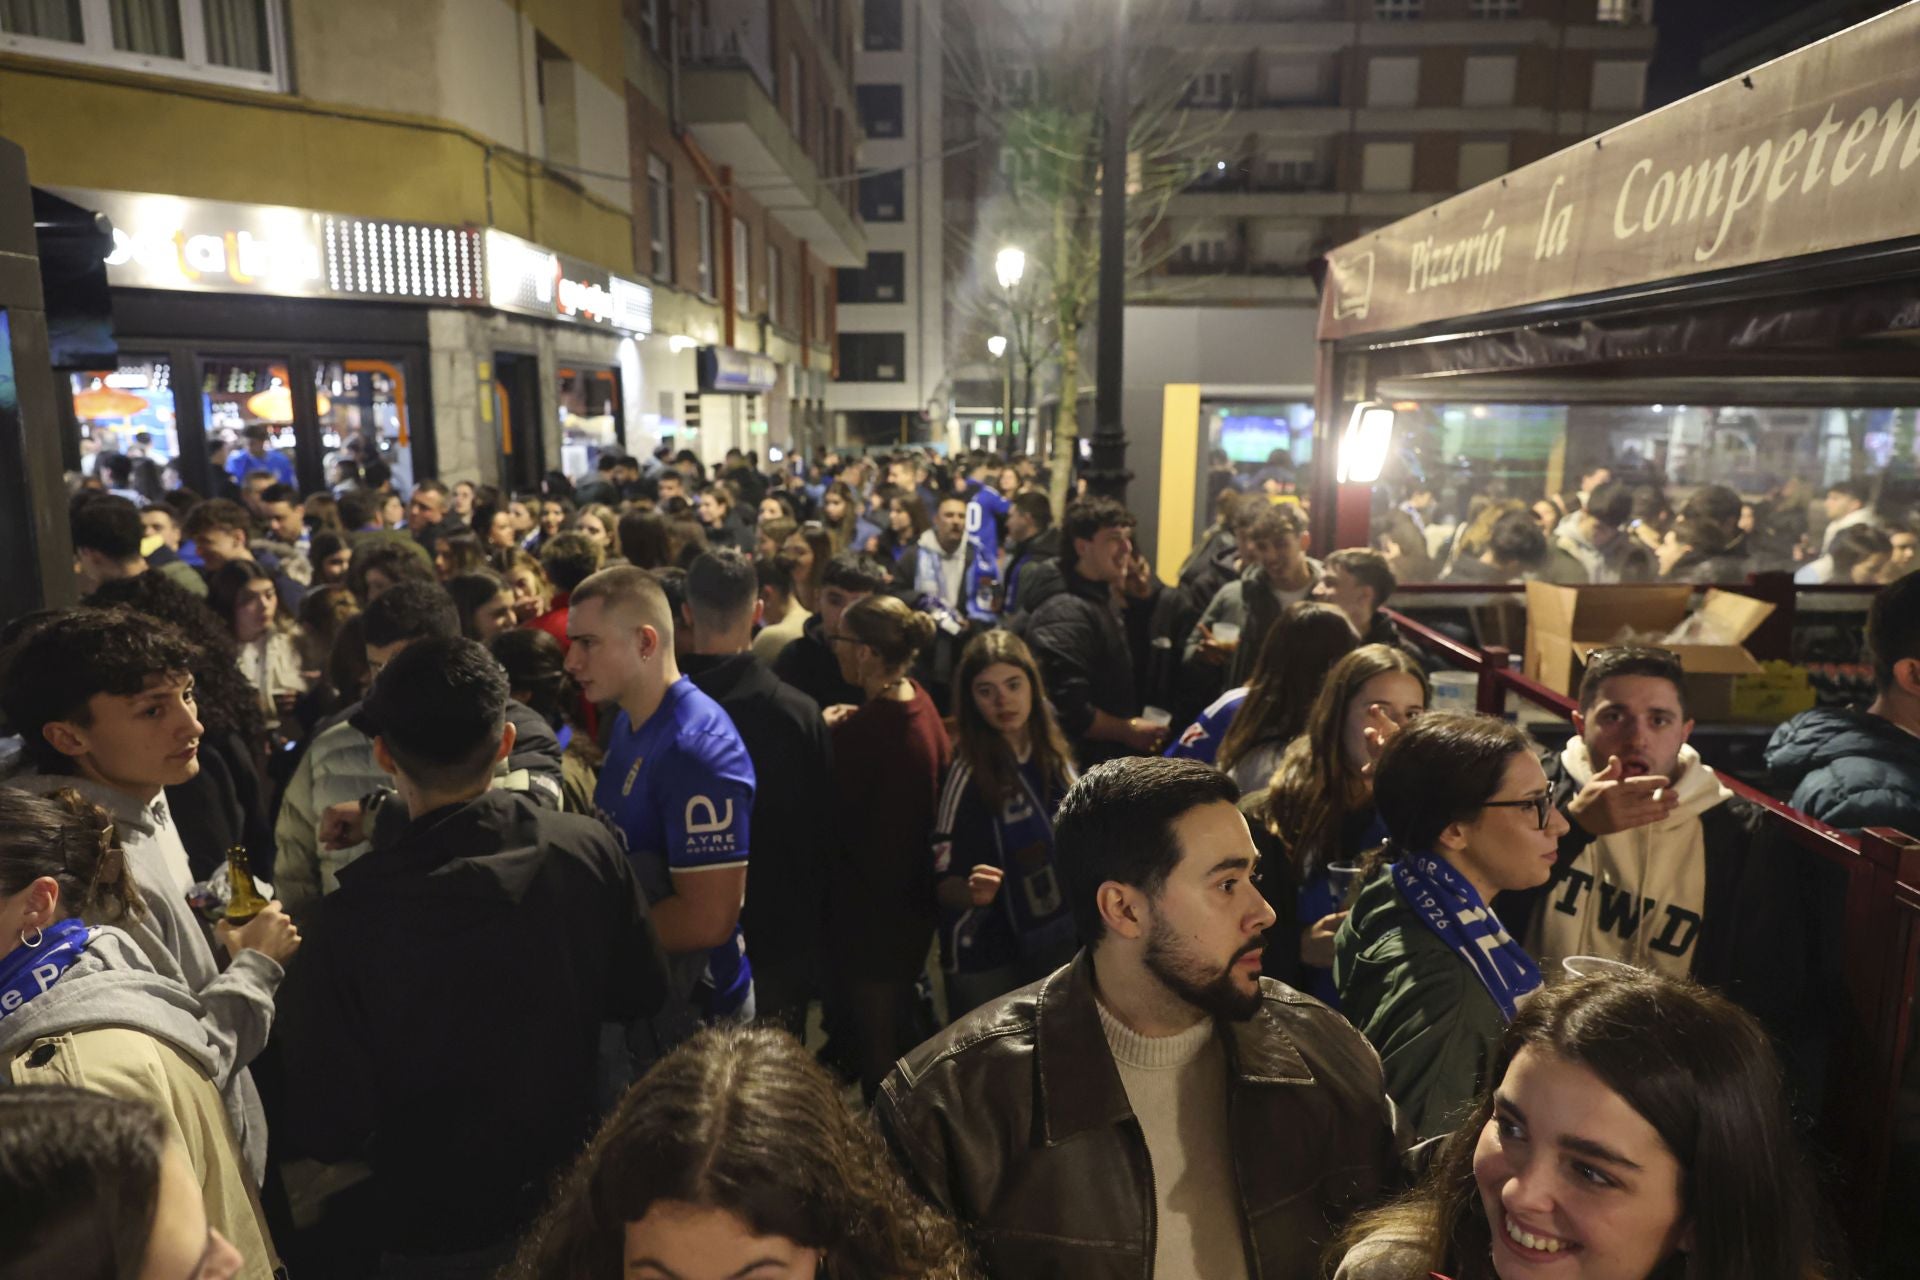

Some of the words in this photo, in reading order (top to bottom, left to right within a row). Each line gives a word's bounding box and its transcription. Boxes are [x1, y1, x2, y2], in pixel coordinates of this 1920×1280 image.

[1406, 210, 1507, 294] Pizzería
[1534, 175, 1574, 261] la
[686, 834, 735, 846] AYRE
[686, 845, 735, 854] HOTELES
[1416, 890, 1451, 930] 1926
